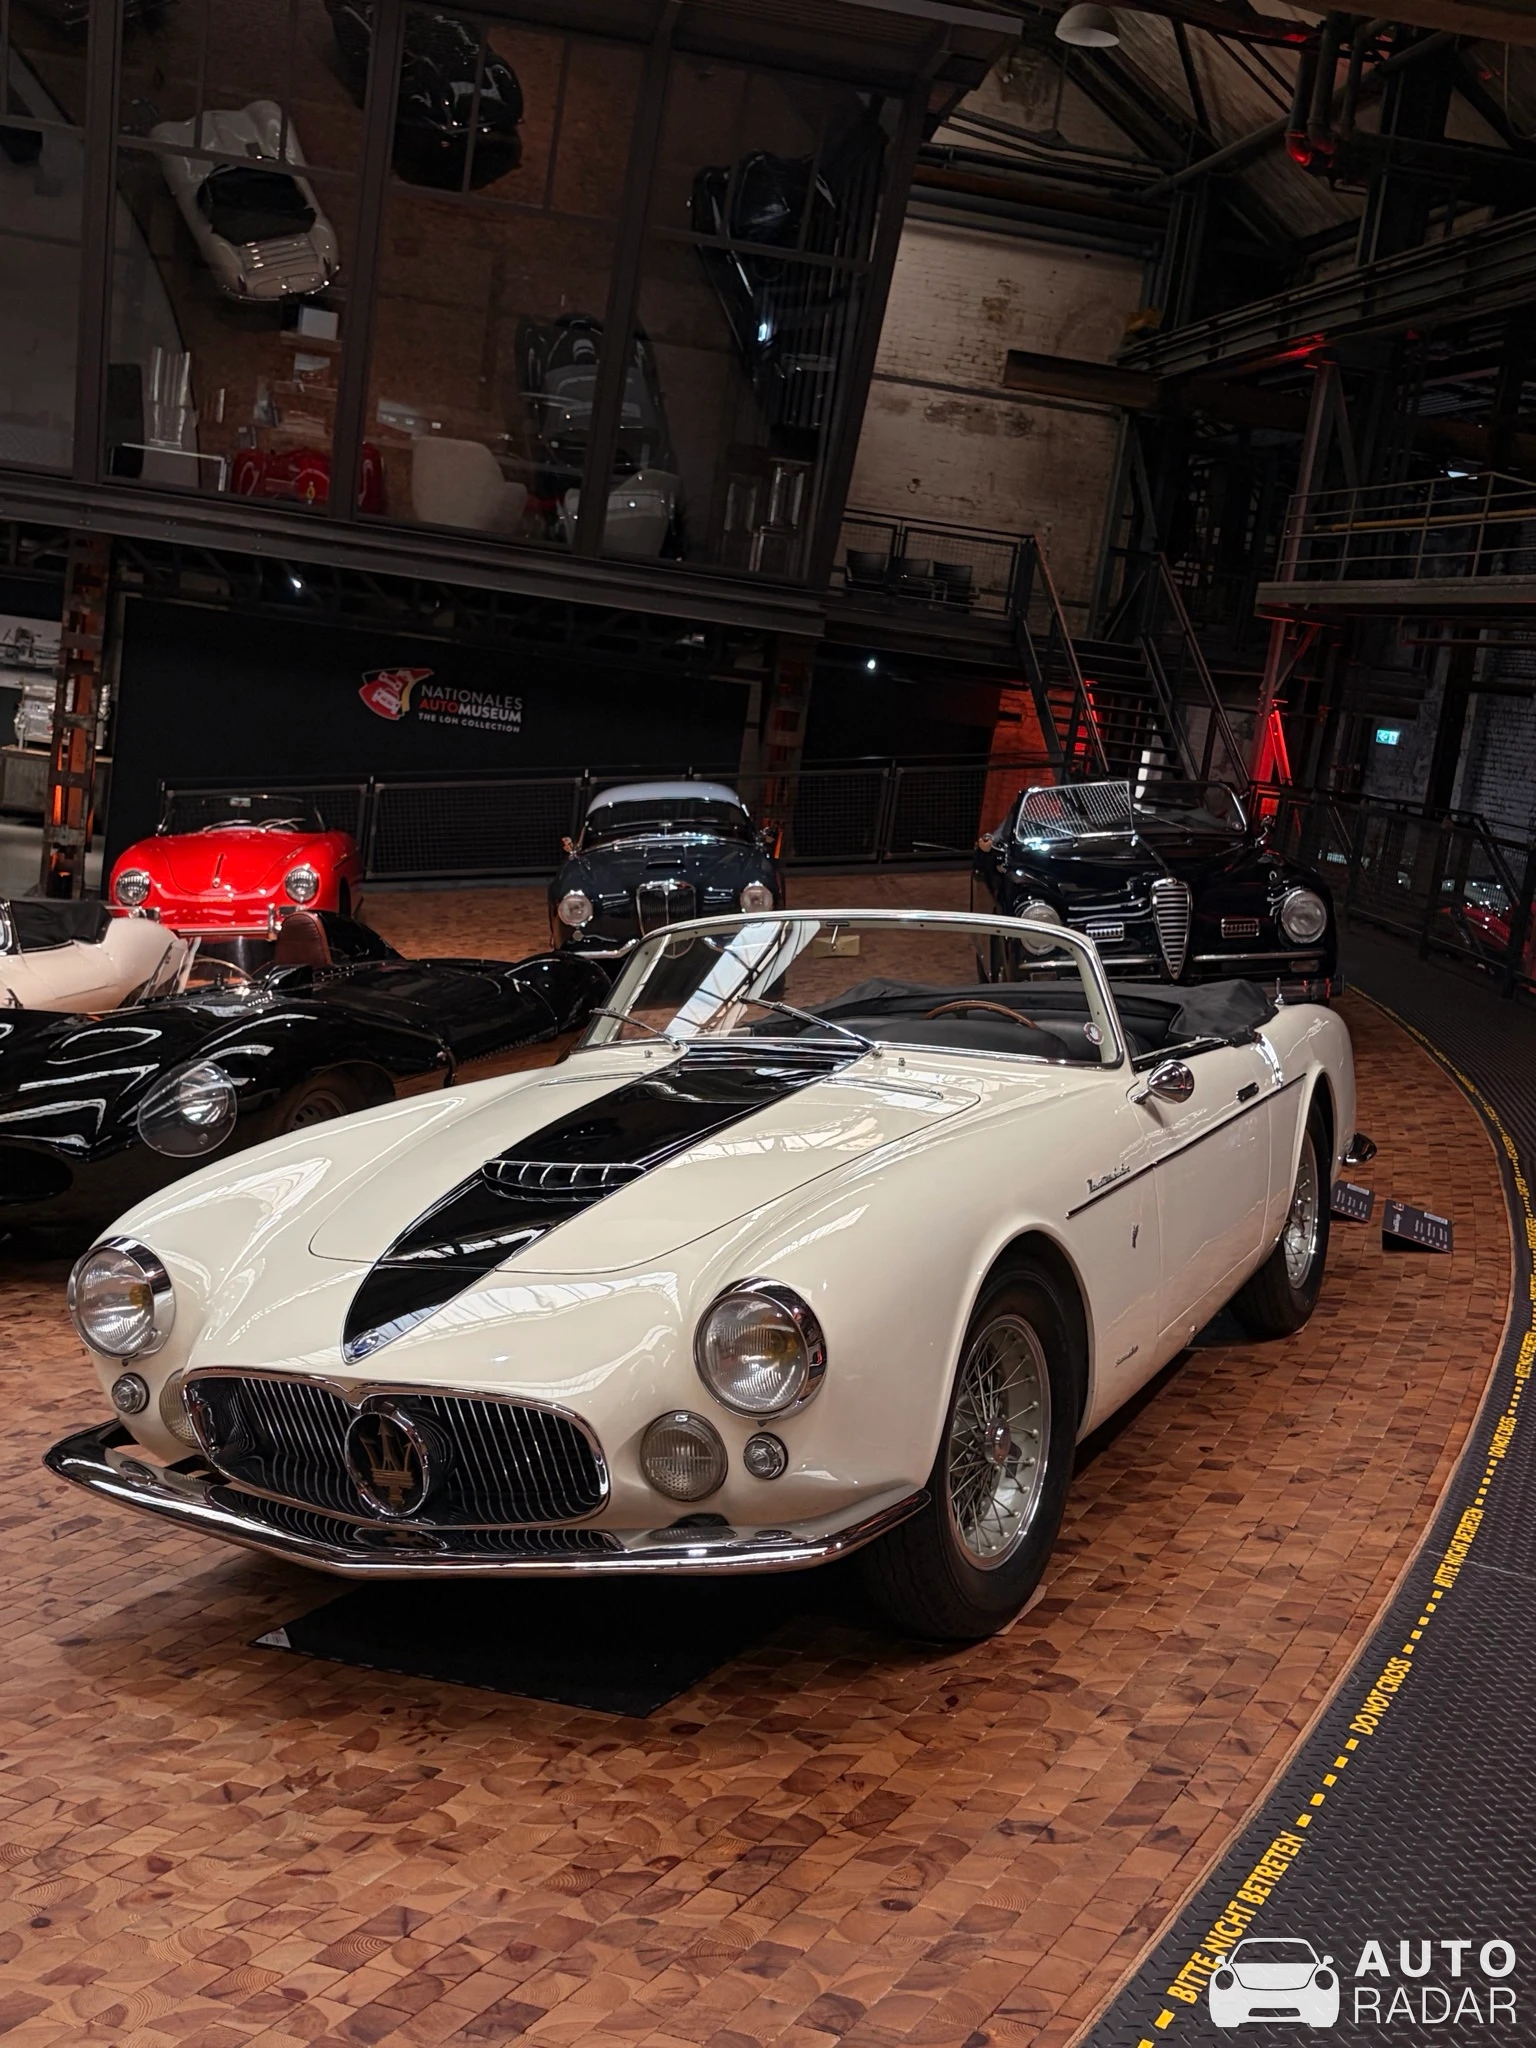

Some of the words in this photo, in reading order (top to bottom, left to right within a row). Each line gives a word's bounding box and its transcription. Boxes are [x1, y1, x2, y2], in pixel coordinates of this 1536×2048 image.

[420, 685, 523, 710] NATIONALES
[418, 712, 436, 722] THE
[439, 715, 458, 725] LOH
[461, 718, 520, 733] COLLECTION
[419, 699, 522, 723] AUTOMUSEUM
[1376, 1656, 1413, 1692] CROSS
[1361, 1688, 1393, 1717] NOT
[1349, 1714, 1379, 1736] DO
[1166, 1951, 1221, 2004] BITTE
[1200, 1900, 1257, 1956] NICHT
[1236, 1830, 1306, 1906] BETRETEN
